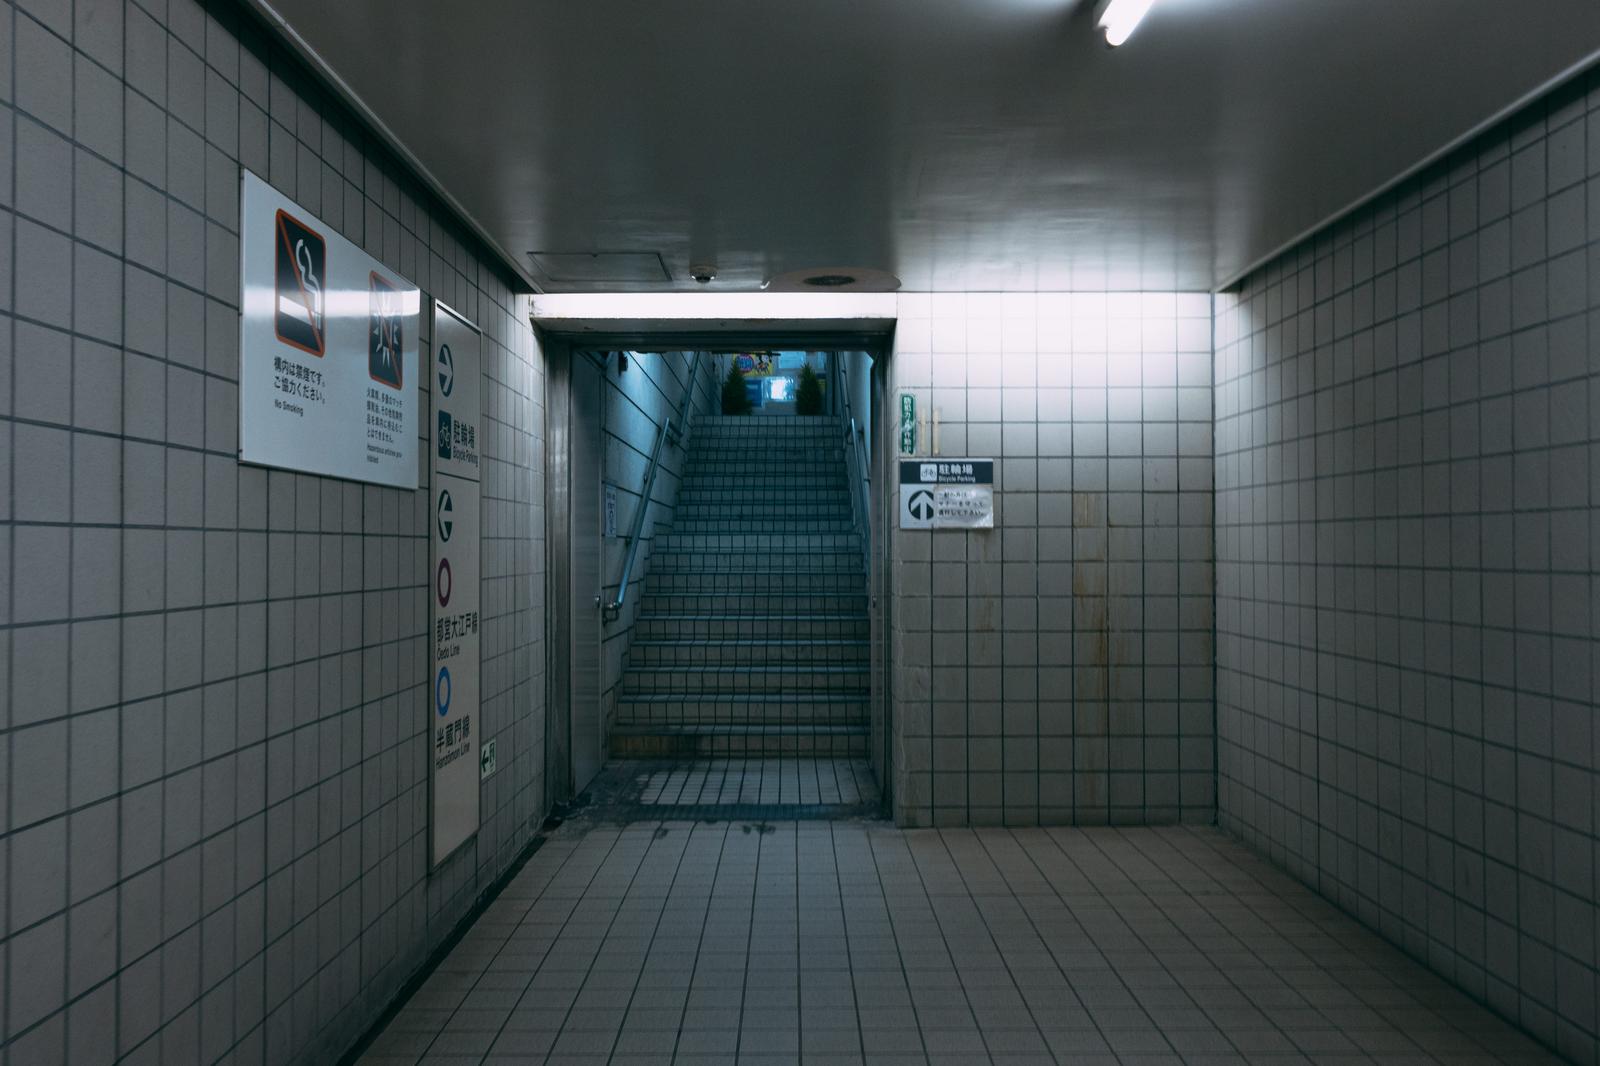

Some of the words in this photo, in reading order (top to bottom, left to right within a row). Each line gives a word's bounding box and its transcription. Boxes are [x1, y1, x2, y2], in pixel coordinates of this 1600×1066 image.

[274, 375, 325, 405] ご協力ください。
[274, 399, 282, 409] No
[283, 400, 304, 417] Smoking
[453, 420, 475, 449] 駐輪場
[453, 445, 465, 463] Bicycle
[466, 449, 479, 468] Parking
[939, 464, 973, 475] 駐輪場
[437, 611, 478, 642] 都営大江戸線
[450, 643, 460, 657] Line
[436, 713, 470, 753] 半蔵門線
[461, 741, 470, 757] Line
